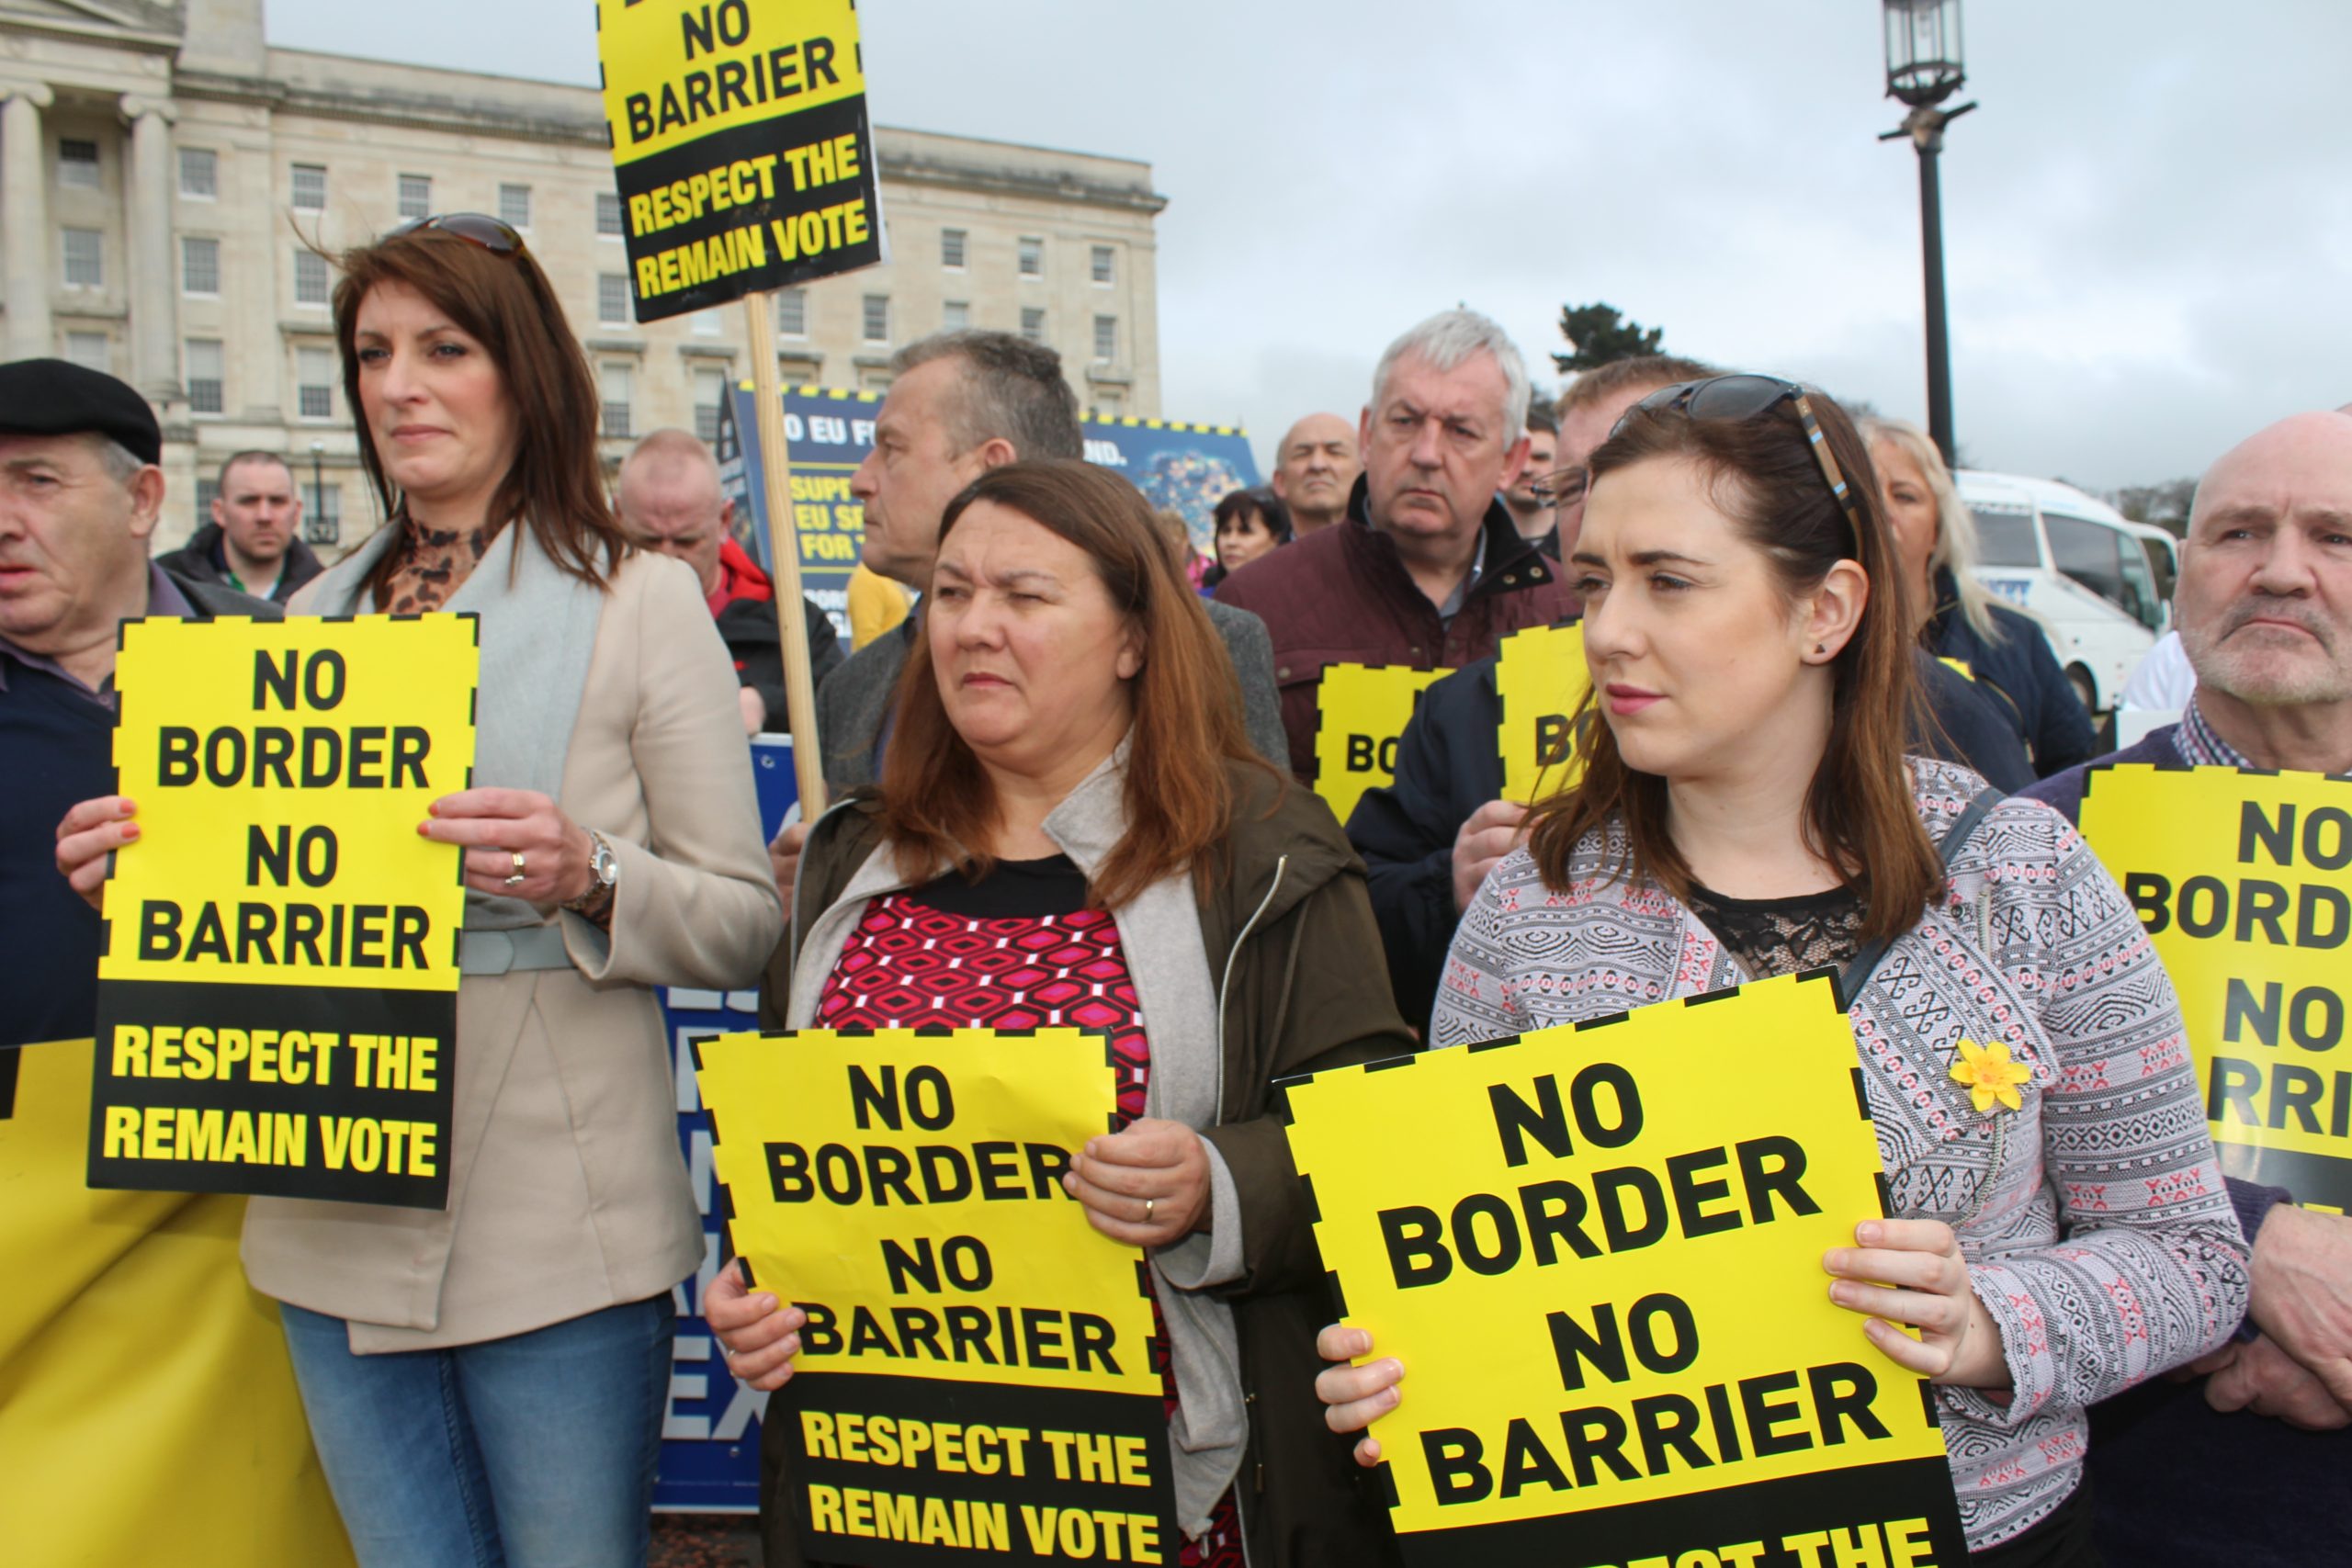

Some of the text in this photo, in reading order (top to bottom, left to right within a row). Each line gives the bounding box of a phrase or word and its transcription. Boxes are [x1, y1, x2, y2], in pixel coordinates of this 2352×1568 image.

[682, 0, 750, 61] NO
[626, 38, 839, 143] BARRIER
[629, 134, 859, 236] RESPECT THE
[637, 198, 868, 299] REMAIN VOTE
[808, 415, 848, 446] EU
[795, 504, 831, 531] EU
[799, 533, 855, 560] FOR
[253, 649, 345, 710] NO
[159, 727, 430, 788] BORDER
[247, 825, 337, 887] NO
[2238, 801, 2352, 870] NO
[139, 900, 429, 969] BARRIER
[2125, 873, 2350, 949] BORD
[2223, 978, 2344, 1052] NO
[112, 1025, 437, 1091] RESPECT THE
[848, 1066, 955, 1131] NO
[1487, 1063, 1643, 1168] NO
[104, 1106, 436, 1177] REMAIN VOTE
[763, 1141, 1080, 1206] BORDER
[1377, 1136, 1822, 1289] BORDER
[880, 1235, 992, 1294] NO
[792, 1302, 1125, 1376] BARRIER
[1546, 1293, 1699, 1391] NO
[800, 1411, 1150, 1486] RESPECT THE
[1419, 1362, 1893, 1506] BARRIER
[808, 1484, 1162, 1564] REMAIN VOTE
